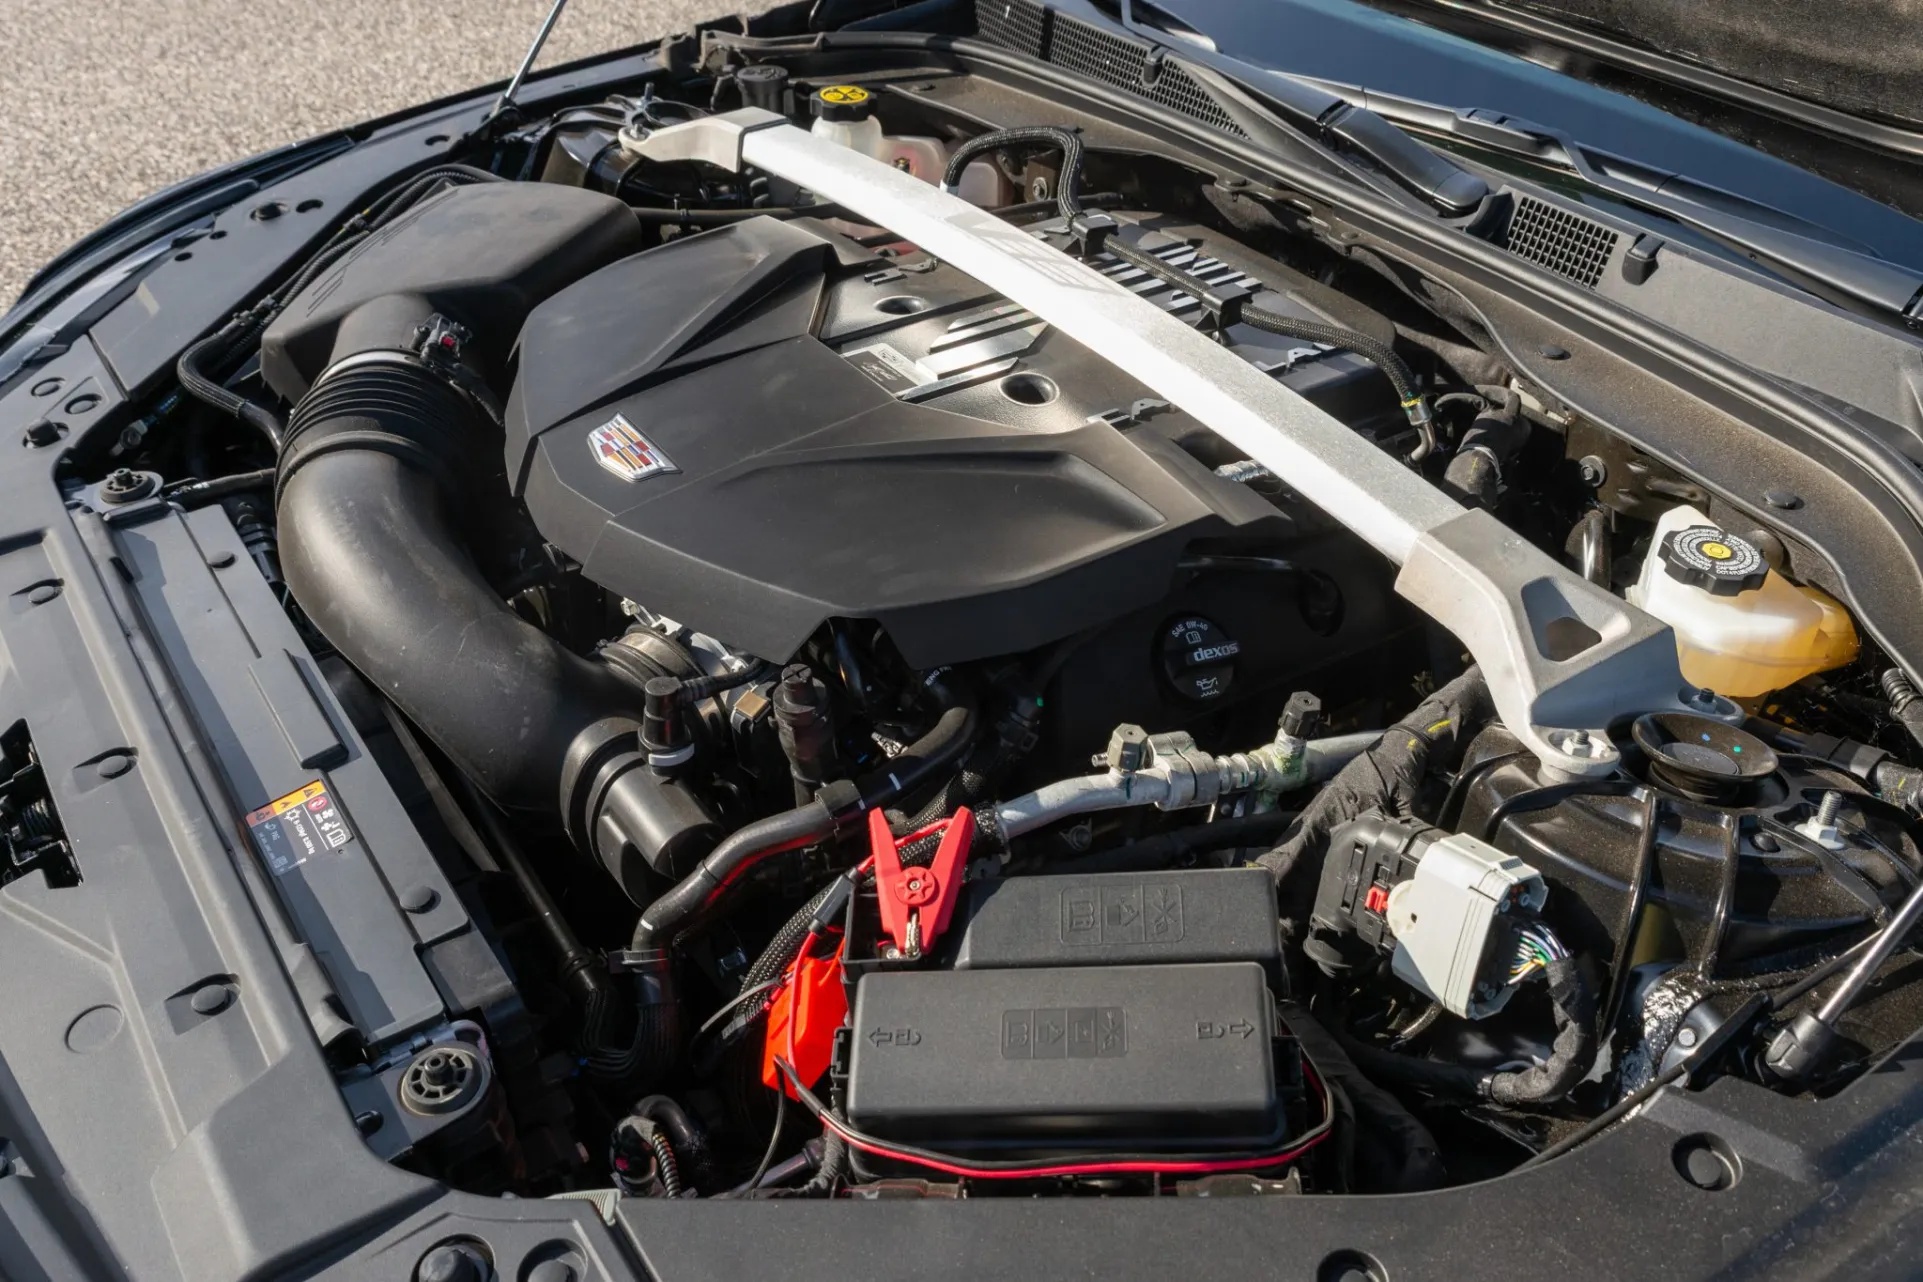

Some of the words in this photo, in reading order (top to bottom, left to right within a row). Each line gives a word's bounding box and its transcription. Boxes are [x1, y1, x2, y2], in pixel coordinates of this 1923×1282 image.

[1172, 624, 1186, 637] SAE
[1186, 620, 1208, 631] 0W-40
[1193, 643, 1238, 662] dexos
